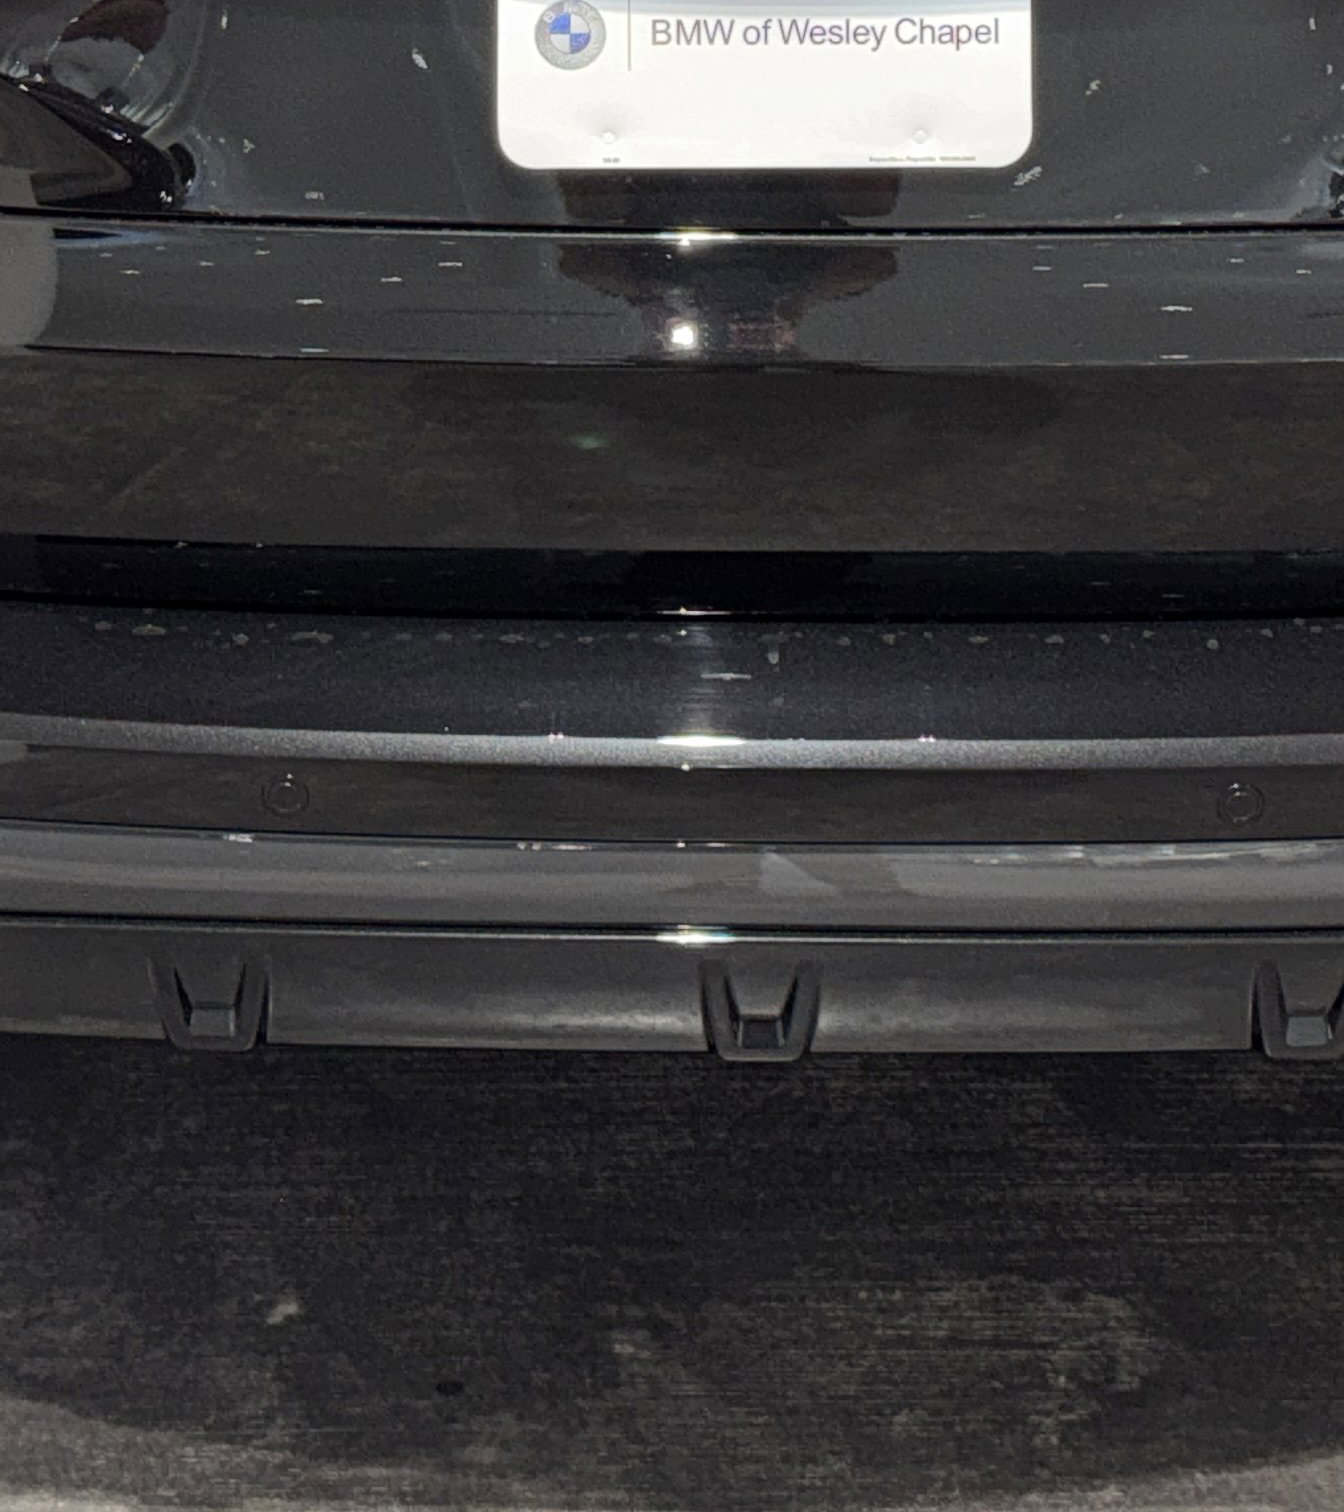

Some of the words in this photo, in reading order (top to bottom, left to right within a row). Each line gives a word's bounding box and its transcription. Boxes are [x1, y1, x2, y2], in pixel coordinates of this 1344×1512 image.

[651, 18, 735, 46] BMW
[742, 18, 772, 46] of
[777, 18, 887, 52] Wesley
[895, 17, 999, 51] Chapel
